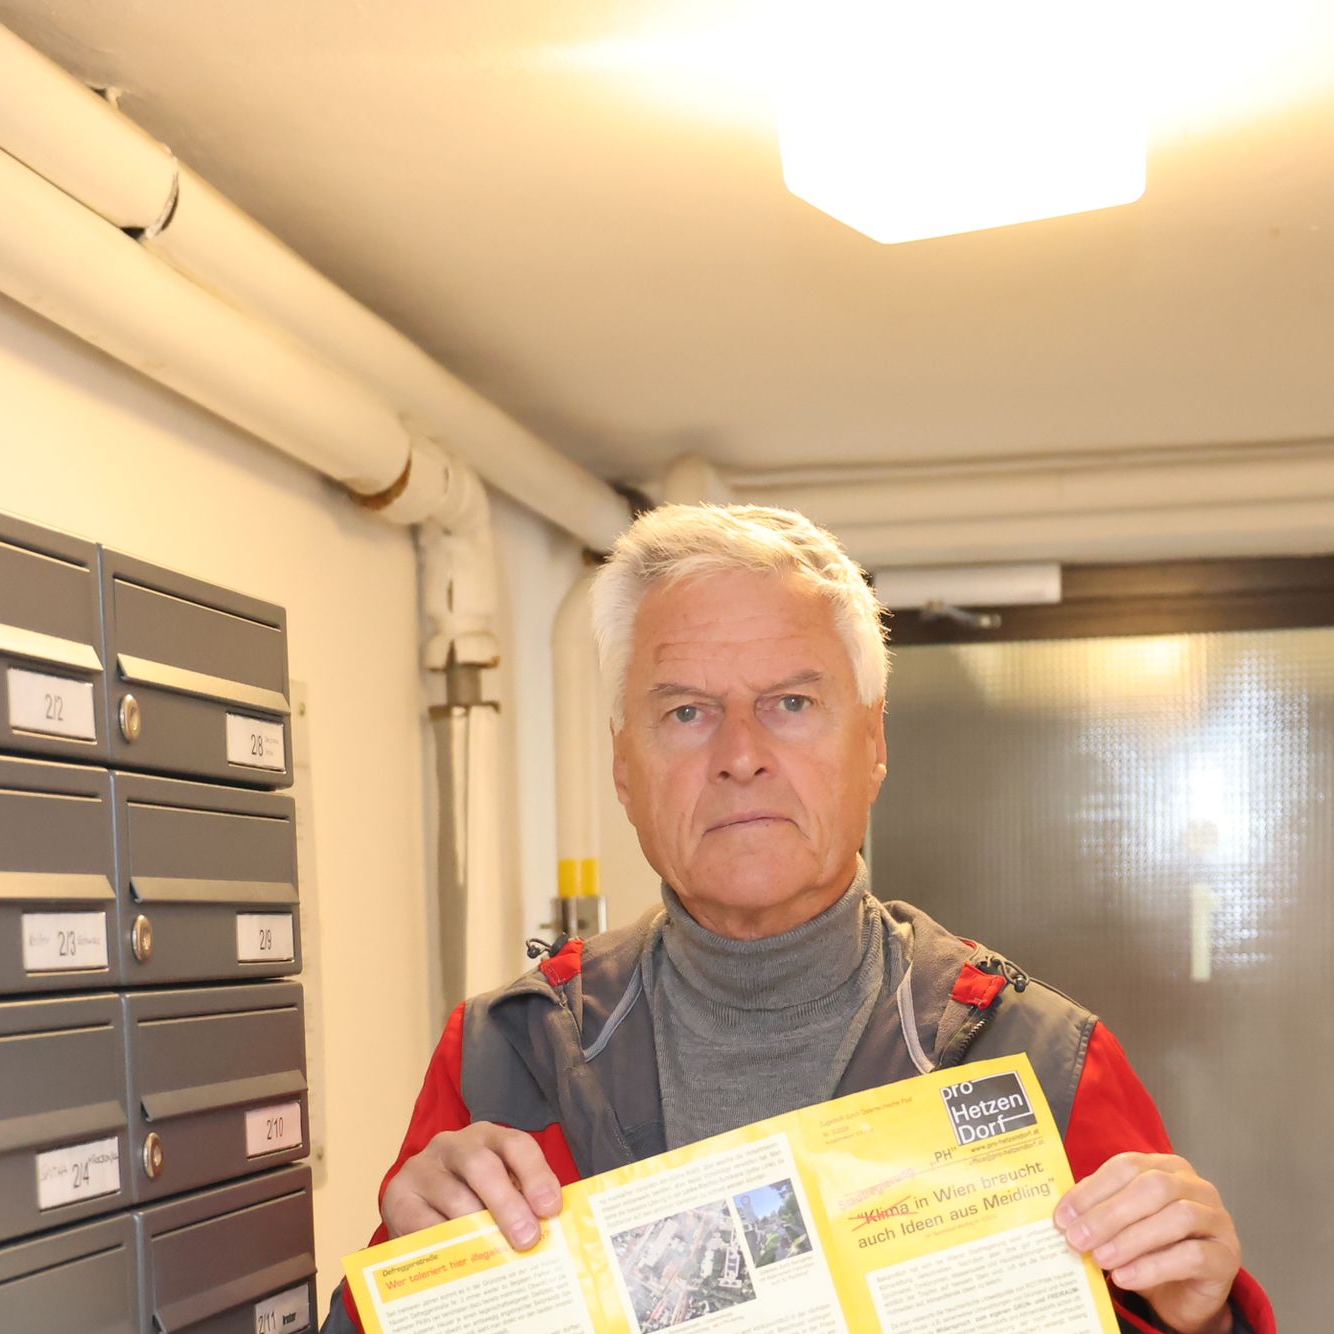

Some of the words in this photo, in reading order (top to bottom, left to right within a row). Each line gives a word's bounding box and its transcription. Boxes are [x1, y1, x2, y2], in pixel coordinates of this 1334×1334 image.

[44, 692, 65, 723] 2/2
[250, 733, 264, 757] 2/8
[58, 930, 77, 957] 2/3
[259, 928, 273, 951] 2/9
[950, 1093, 1024, 1124] Hetzen
[266, 1116, 284, 1140] 2/10
[957, 1115, 1007, 1145] Dorf
[71, 1160, 90, 1189] 2/4
[915, 1195, 930, 1210] in
[932, 1181, 977, 1205] Wien
[981, 1161, 1045, 1191] braucht
[857, 1227, 897, 1250] auch
[901, 1214, 944, 1237] Ideen
[949, 1206, 978, 1222] aus
[386, 1278, 406, 1291] Wer
[409, 1263, 447, 1283] toleriert
[450, 1258, 467, 1270] hier
